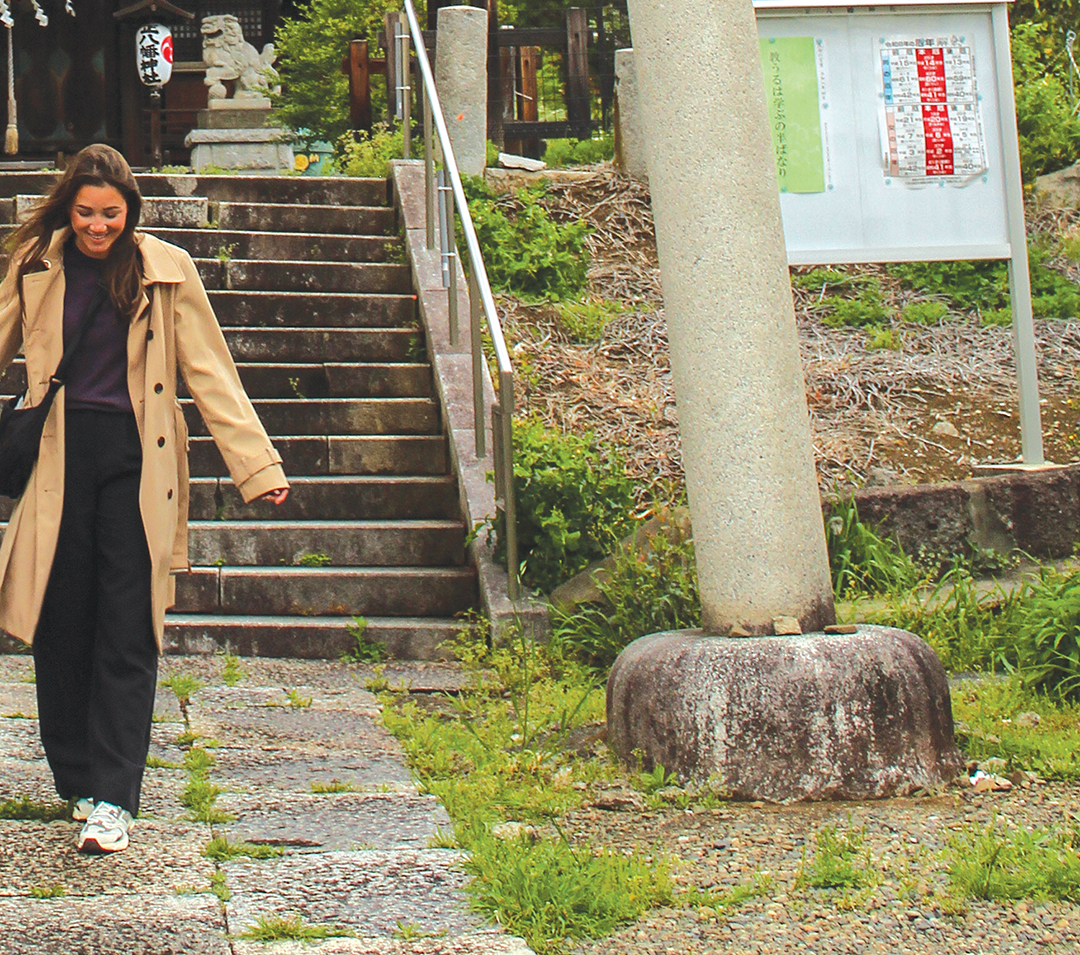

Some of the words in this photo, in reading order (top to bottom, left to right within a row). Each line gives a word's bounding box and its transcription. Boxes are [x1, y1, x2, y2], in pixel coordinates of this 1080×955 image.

[139, 25, 161, 84] 正八幡神社
